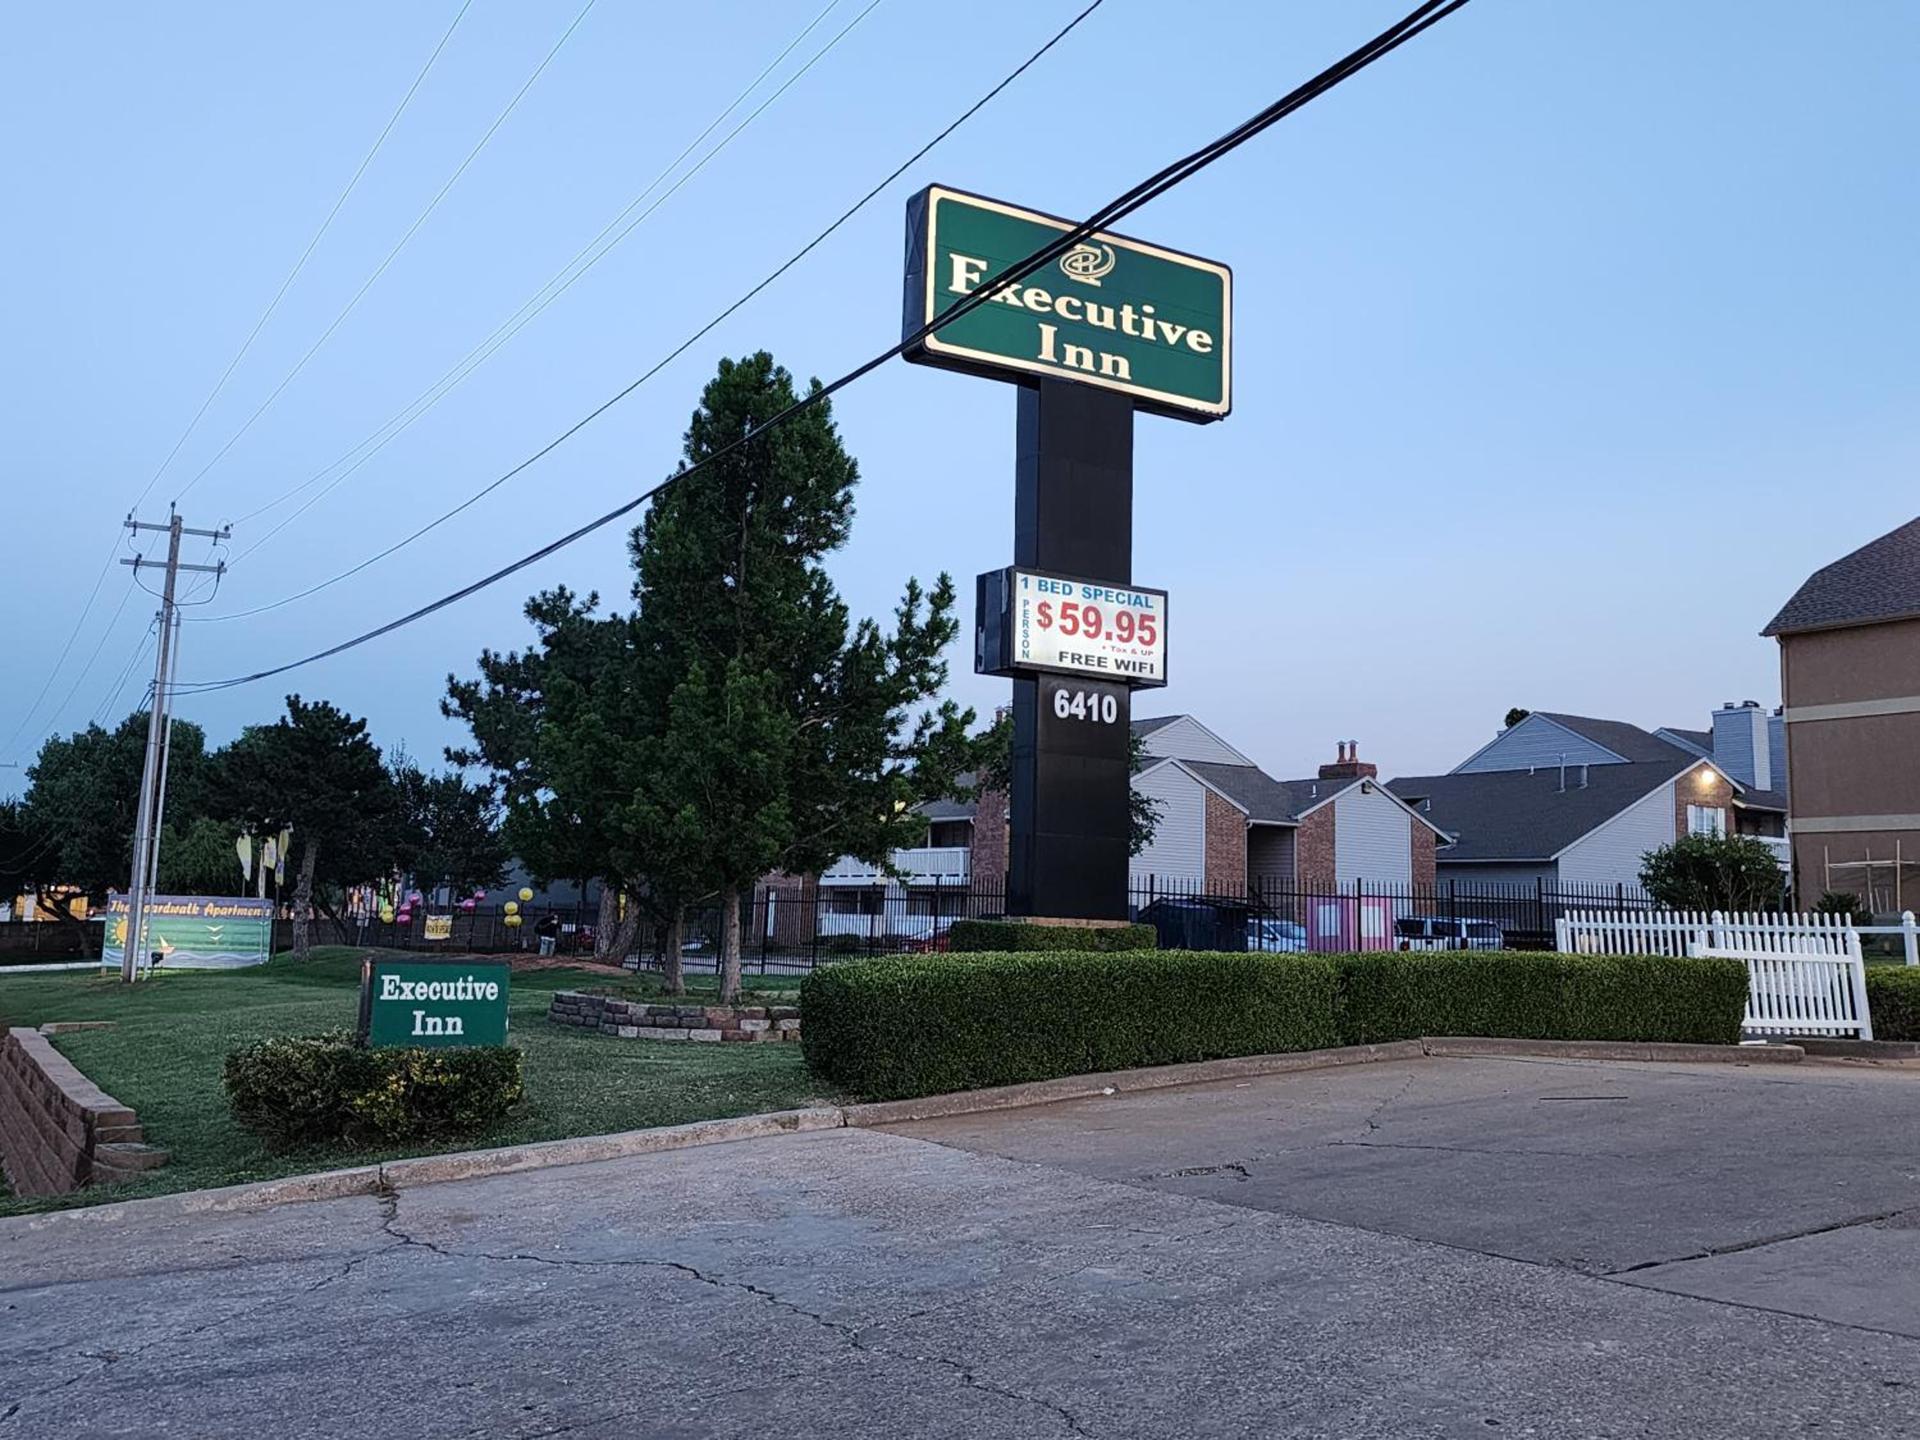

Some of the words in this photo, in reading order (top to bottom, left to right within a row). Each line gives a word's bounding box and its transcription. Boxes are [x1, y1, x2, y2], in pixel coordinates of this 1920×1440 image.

[948, 253, 1212, 353] Executive
[1037, 323, 1132, 380] Inn
[1020, 576, 1029, 590] 1
[1037, 579, 1073, 596] BED
[1081, 586, 1154, 609] SPECIAL
[1021, 599, 1030, 659] PERSON
[1036, 600, 1157, 646] $59.95
[1058, 651, 1108, 669] FREE
[1114, 658, 1154, 675] WIFI
[1054, 689, 1117, 724] 6410
[143, 902, 200, 914] oardwalk
[204, 902, 271, 918] Apartmens
[379, 974, 499, 1000] Executive
[411, 1010, 464, 1036] Inn
